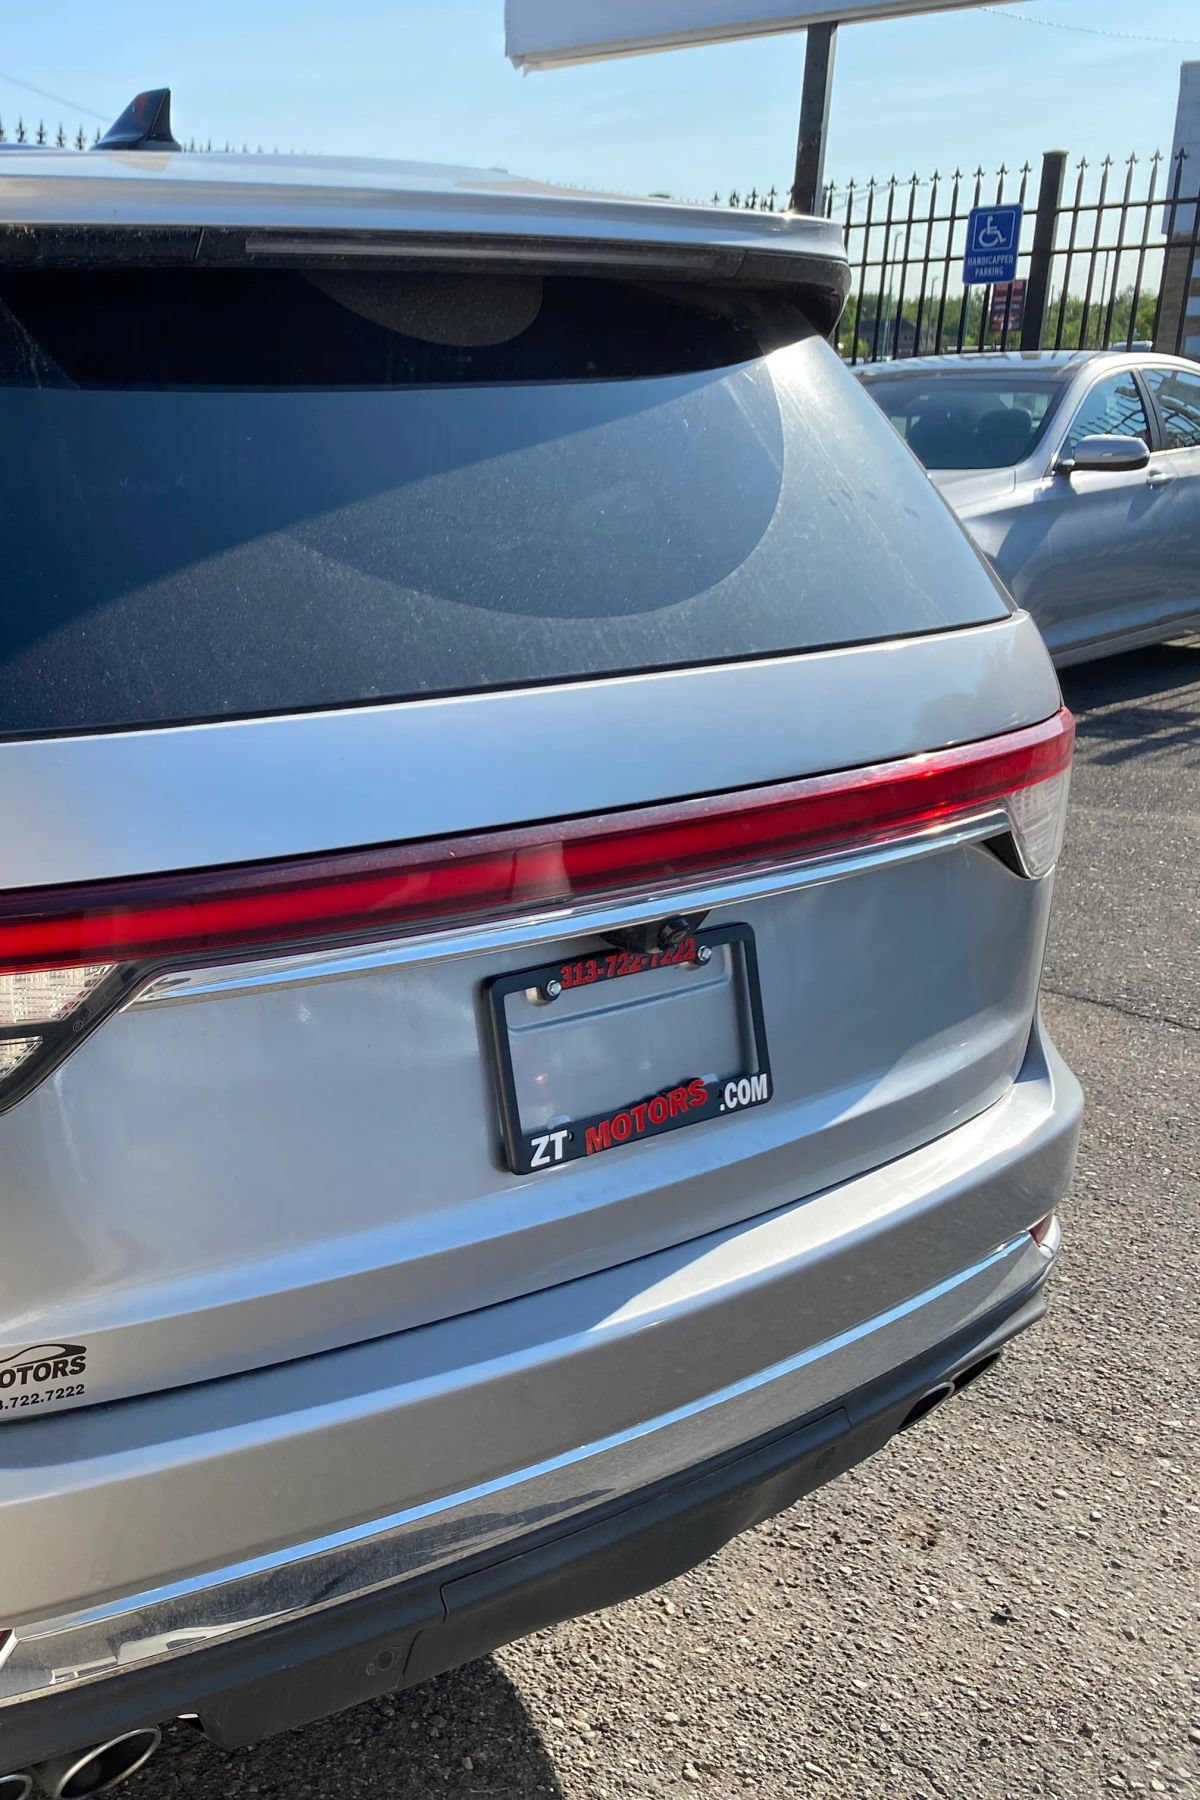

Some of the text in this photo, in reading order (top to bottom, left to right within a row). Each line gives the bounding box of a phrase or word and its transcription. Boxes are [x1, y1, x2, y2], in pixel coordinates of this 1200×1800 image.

[967, 254, 1014, 266] HANDICAPPED
[975, 266, 1004, 277] PARKING
[530, 1073, 769, 1168] ZT MOTORS .COM
